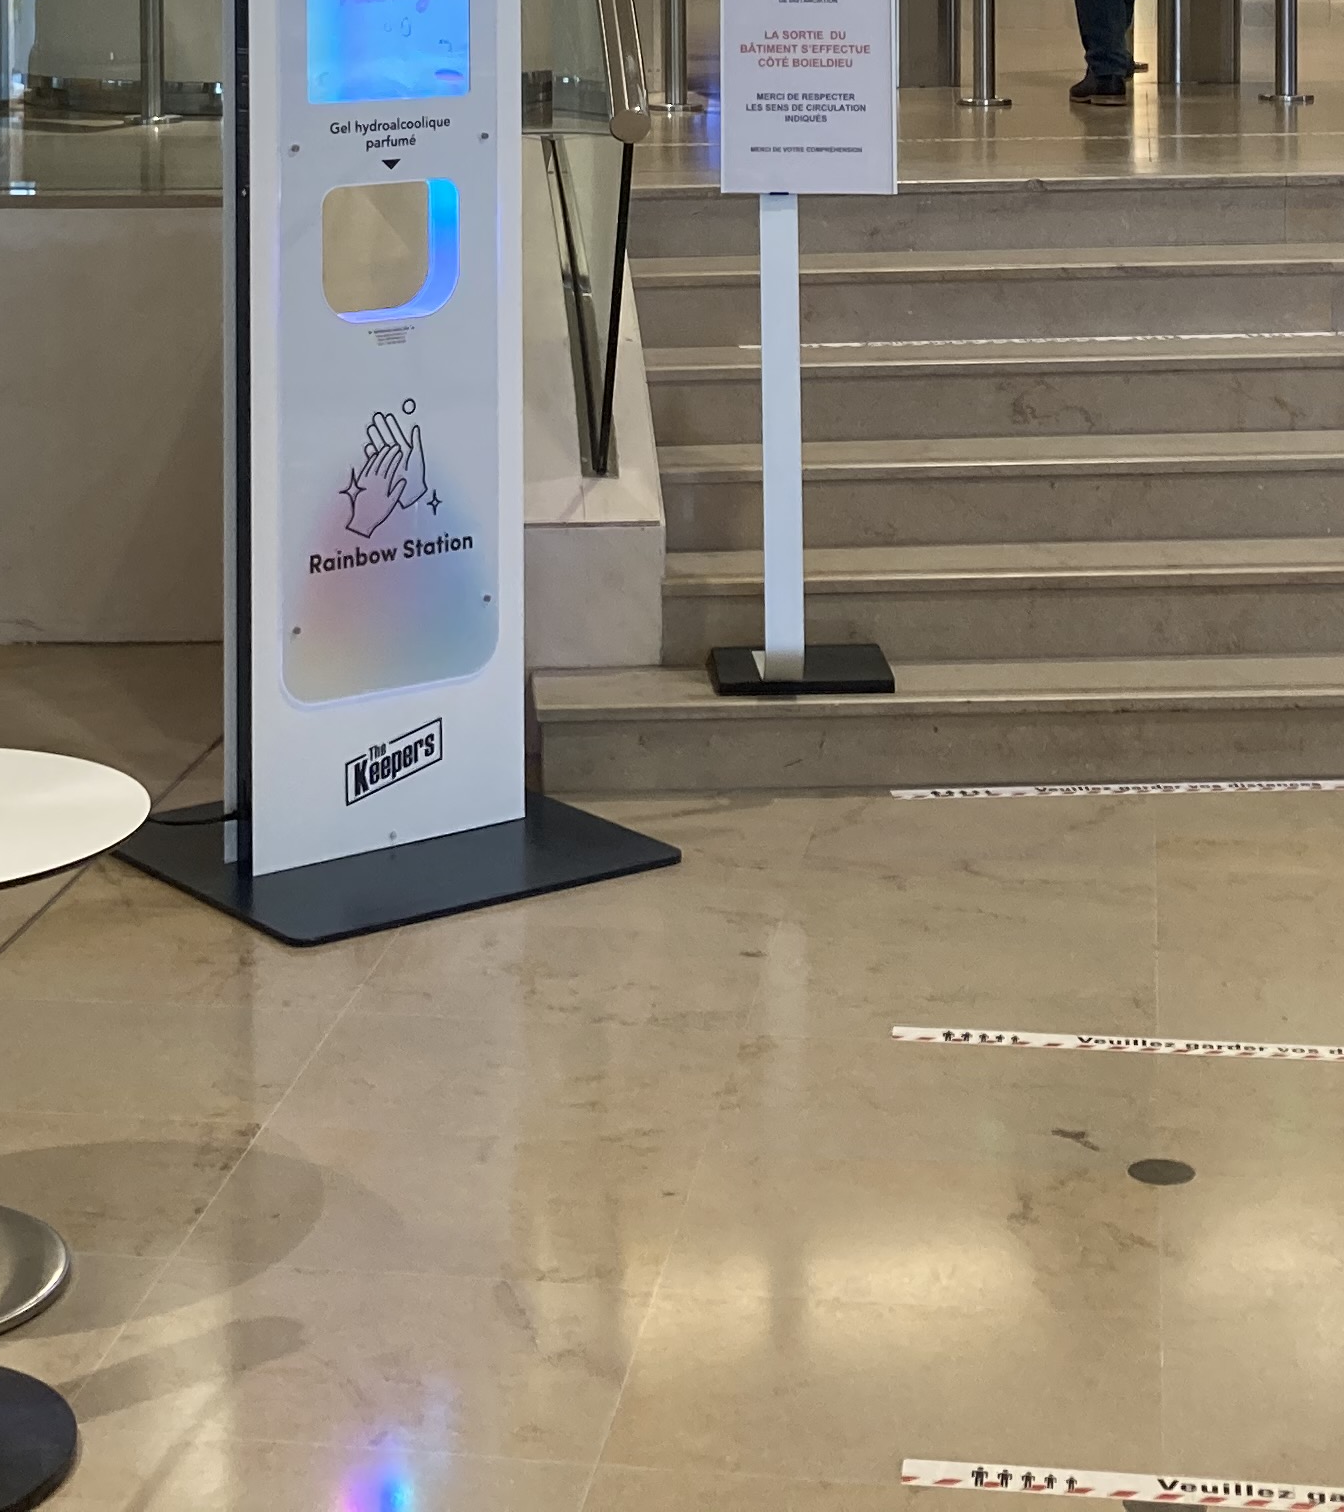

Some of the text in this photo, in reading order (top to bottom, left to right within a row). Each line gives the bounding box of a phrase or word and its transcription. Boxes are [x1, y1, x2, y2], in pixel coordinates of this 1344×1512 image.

[764, 31, 846, 40] LA SORTIE DU
[740, 42, 871, 54] BÂTIMENT S'EFFECTUE
[758, 56, 853, 68] CÔTÉ BOIELDIEU
[756, 93, 855, 101] MERCI DE RESPECTER
[746, 104, 866, 112] LES SENS DE CIRCULATION
[329, 115, 451, 136] Gel hydroalcoolique
[784, 113, 828, 122] INDIQUÉS
[366, 134, 417, 152] parfumé
[309, 532, 474, 574] Rainbow Station
[369, 743, 387, 762] The
[354, 732, 435, 797] Keepers
[1077, 1036, 1176, 1048] Veuillez
[1185, 1042, 1266, 1053] garder
[1277, 1047, 1320, 1055] vos
[1157, 1477, 1296, 1500] Veuillez
